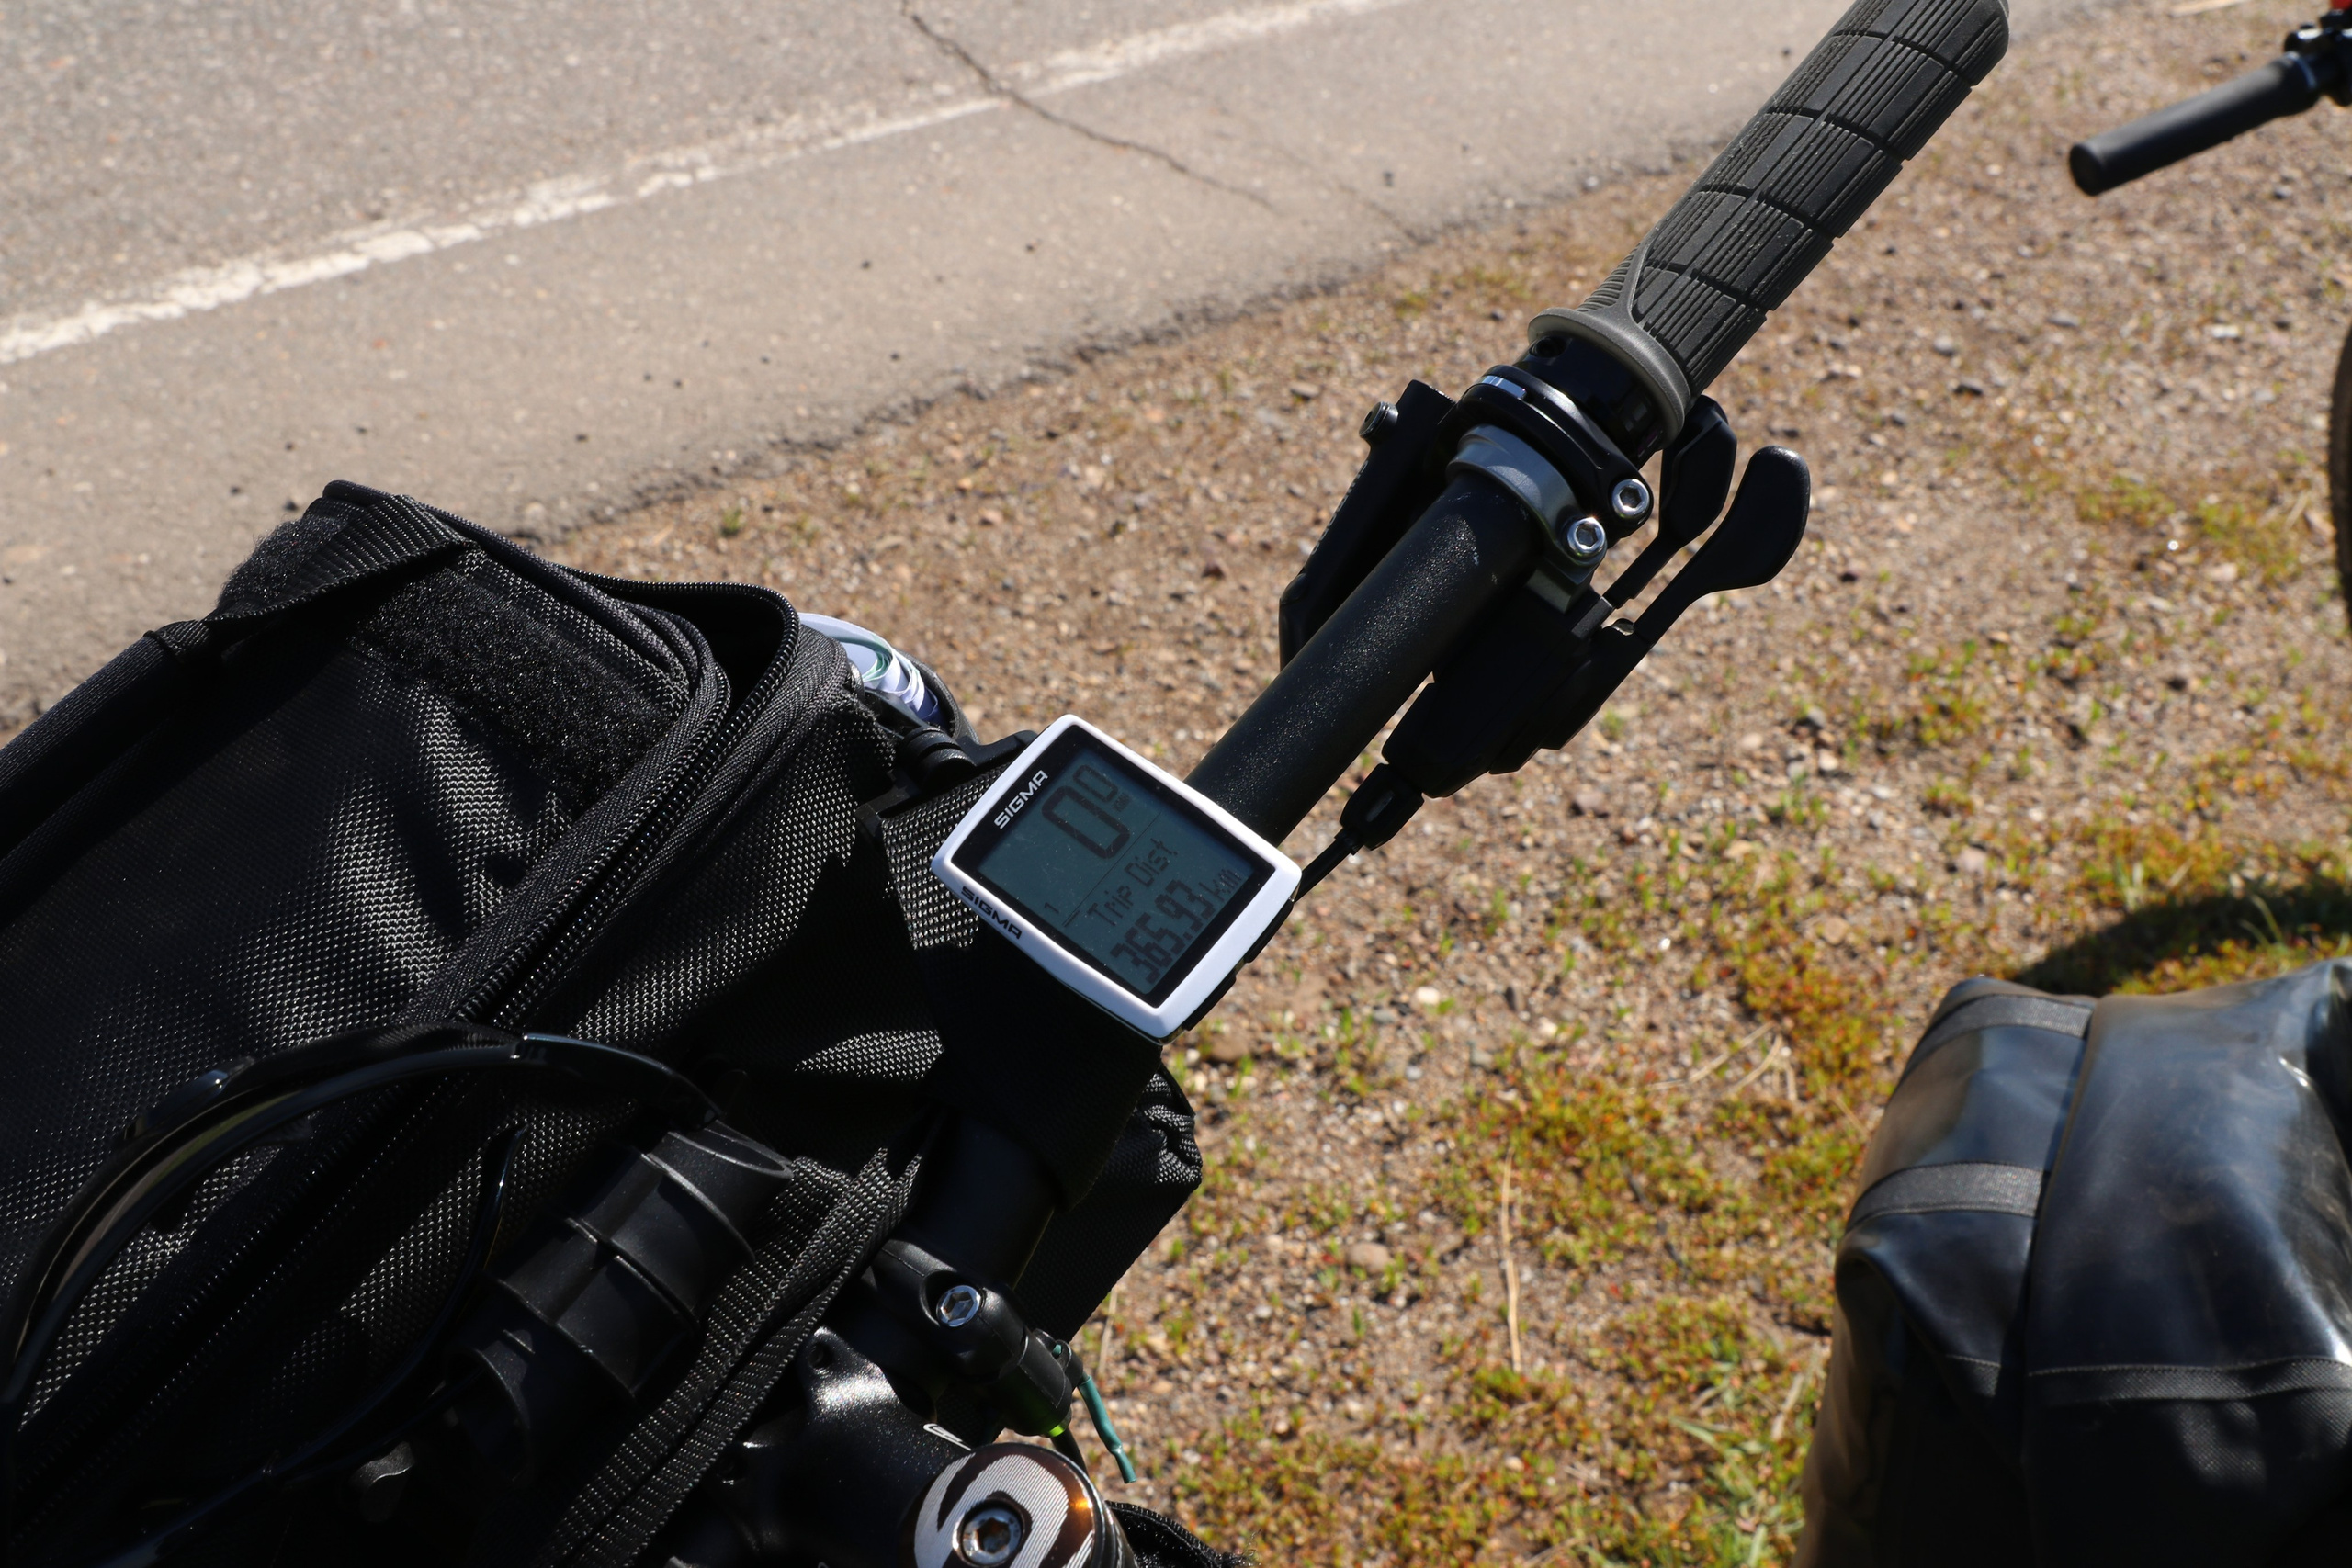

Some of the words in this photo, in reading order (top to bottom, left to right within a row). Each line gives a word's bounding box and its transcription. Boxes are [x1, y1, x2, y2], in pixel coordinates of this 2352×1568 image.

[994, 770, 1048, 829] SIGMA
[961, 886, 1023, 940] SIGMA
[1087, 885, 1134, 927] Trip
[1110, 879, 1216, 984] 365.93
[1198, 868, 1242, 902] km
